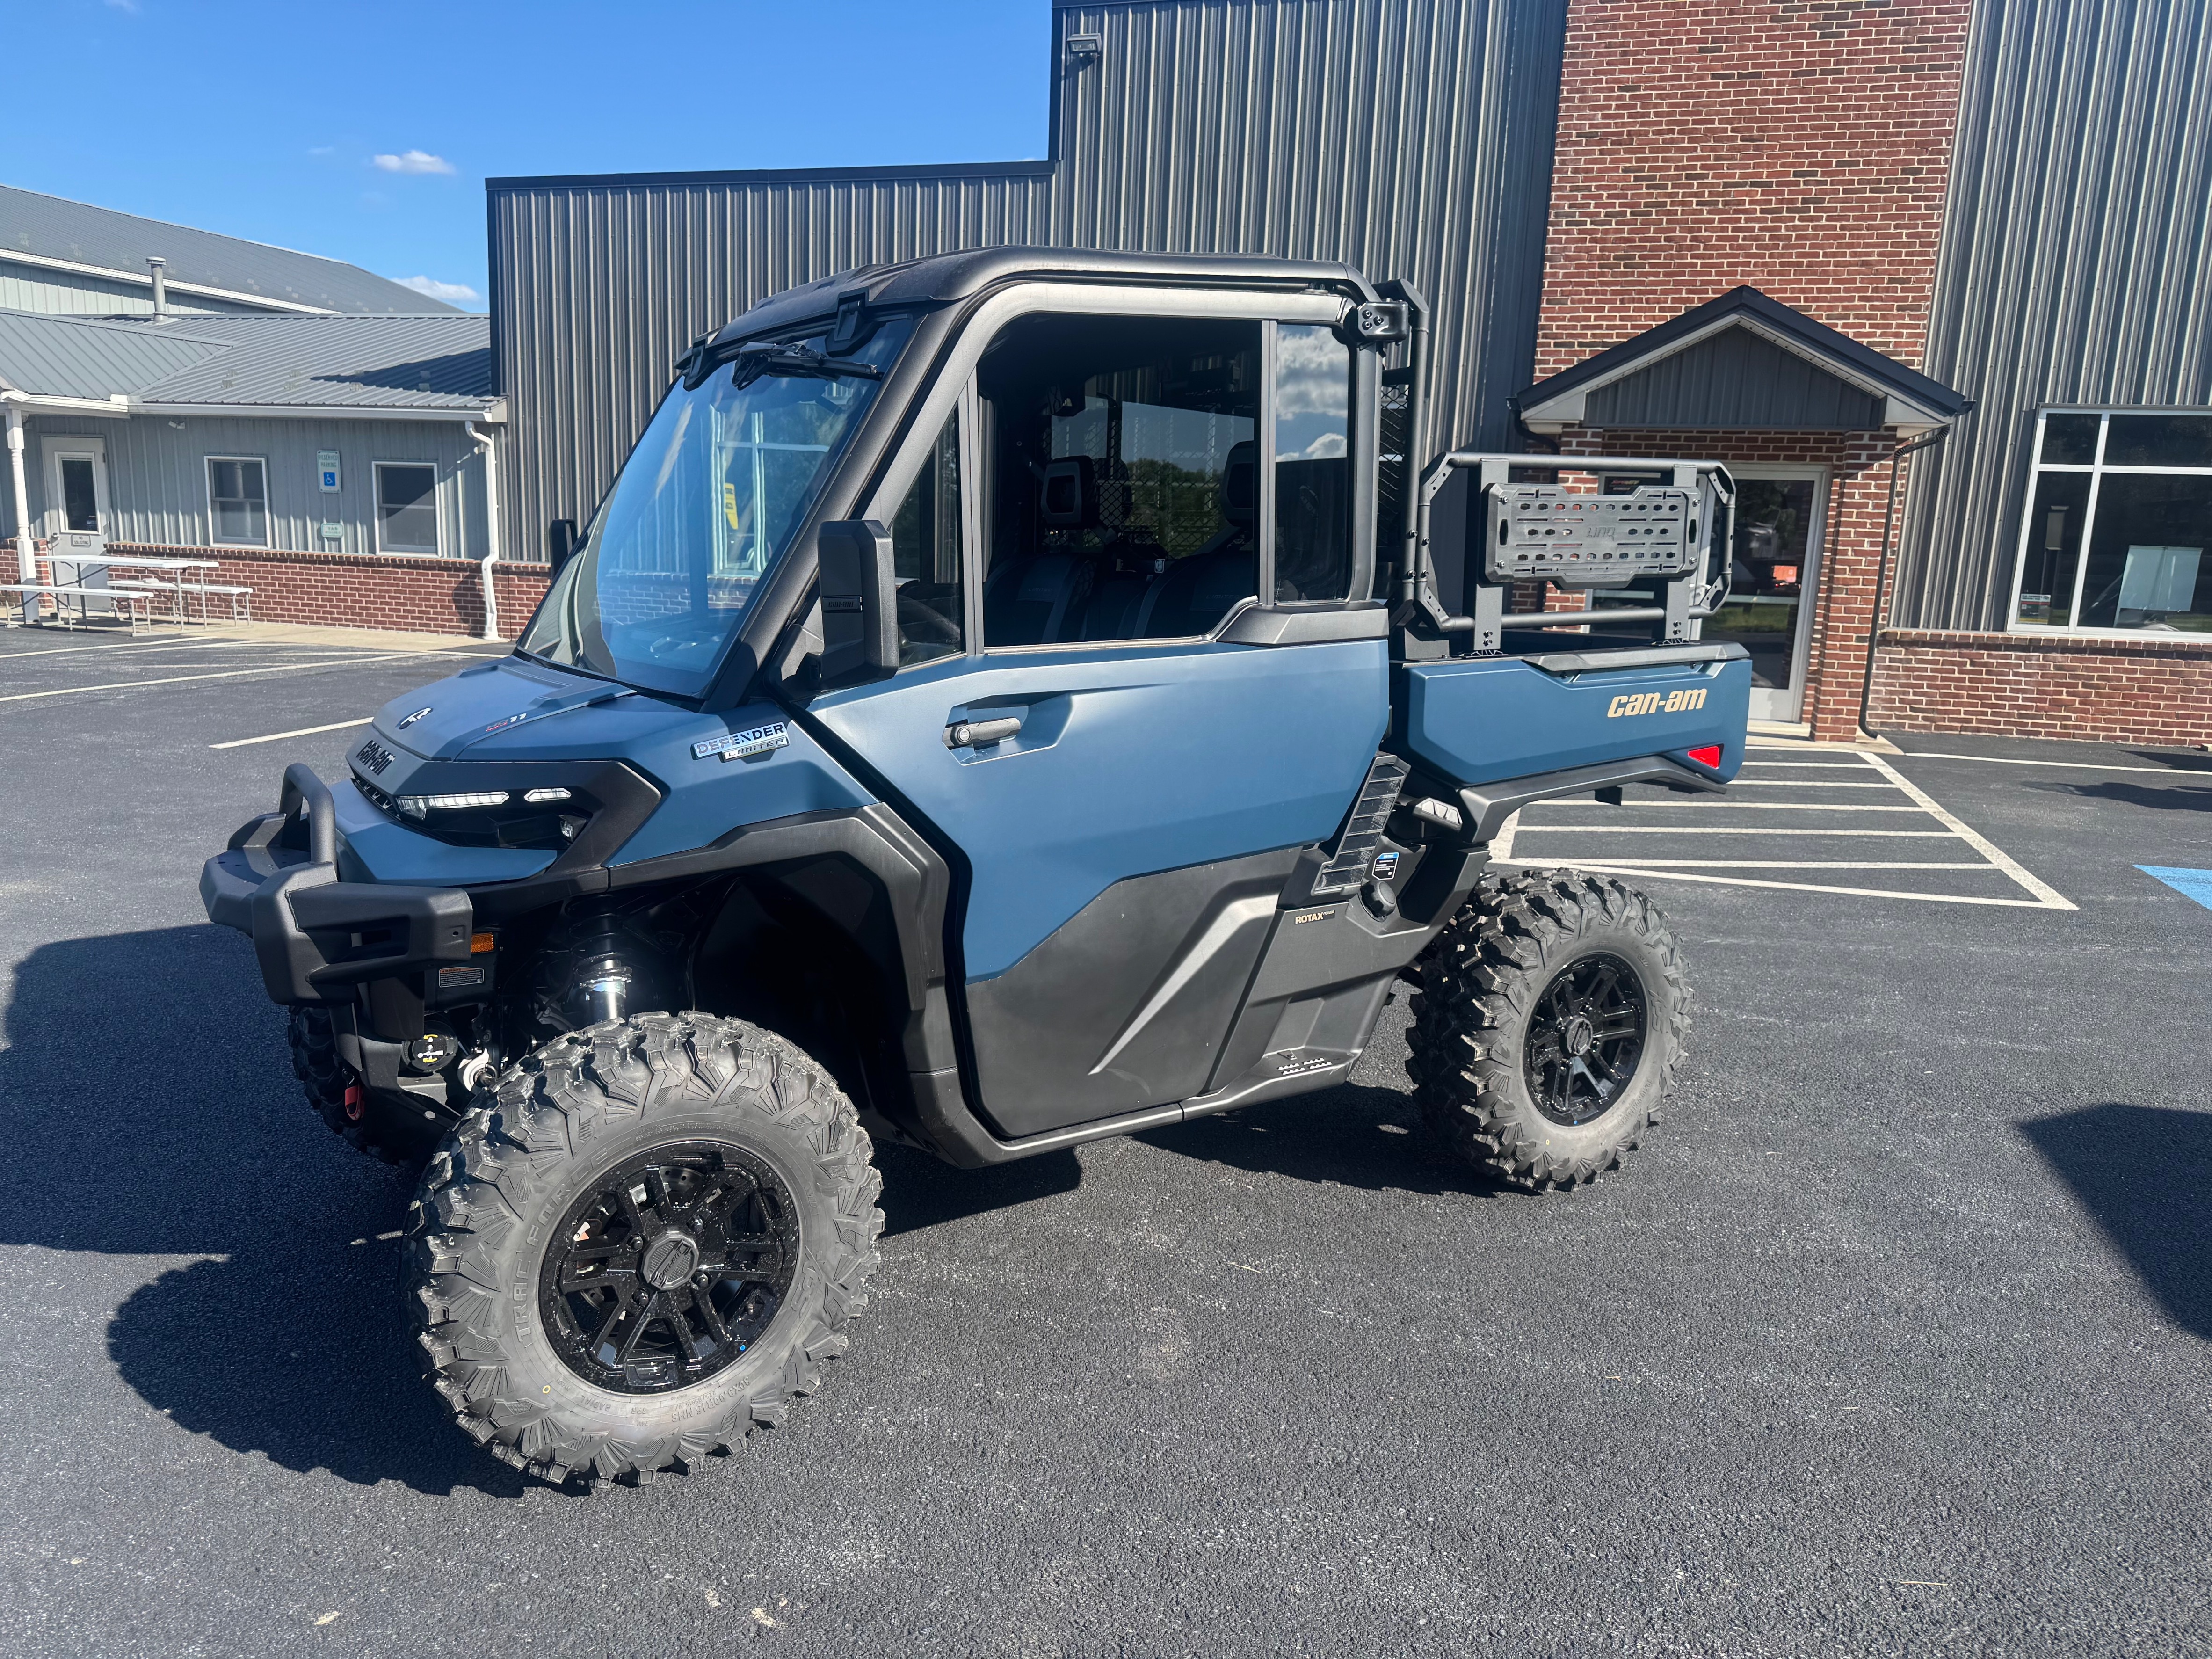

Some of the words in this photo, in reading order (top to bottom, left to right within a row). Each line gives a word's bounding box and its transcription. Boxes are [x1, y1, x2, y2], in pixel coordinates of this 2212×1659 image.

[1607, 688, 1707, 718] can-am
[697, 724, 784, 754] DEFENDER
[1295, 912, 1323, 924] ROTAX
[581, 1395, 612, 1412] RADIAL
